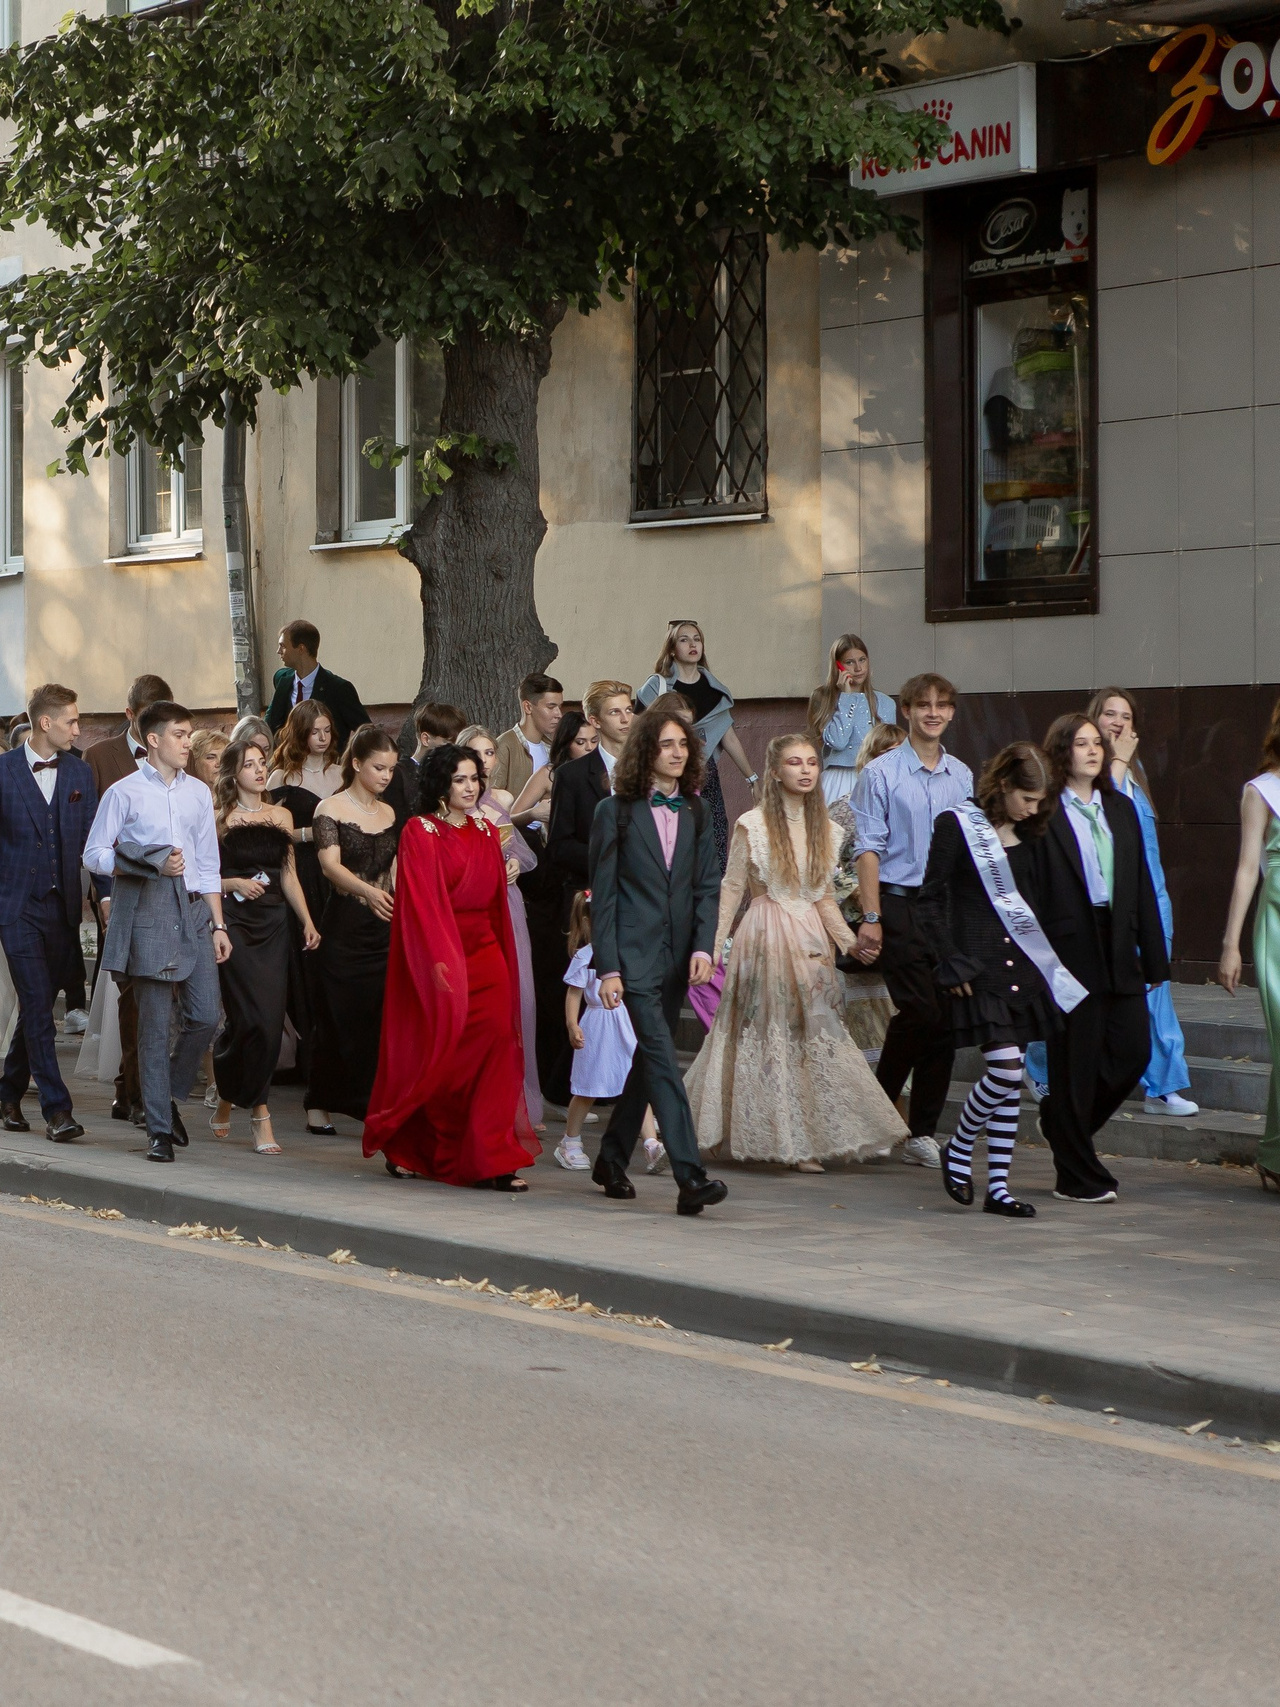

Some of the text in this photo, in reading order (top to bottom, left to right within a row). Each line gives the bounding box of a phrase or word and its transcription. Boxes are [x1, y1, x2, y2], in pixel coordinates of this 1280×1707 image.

[937, 120, 1011, 165] CANIN
[986, 212, 1030, 245] Cesar
[969, 811, 1040, 936] Выпускница 2024
